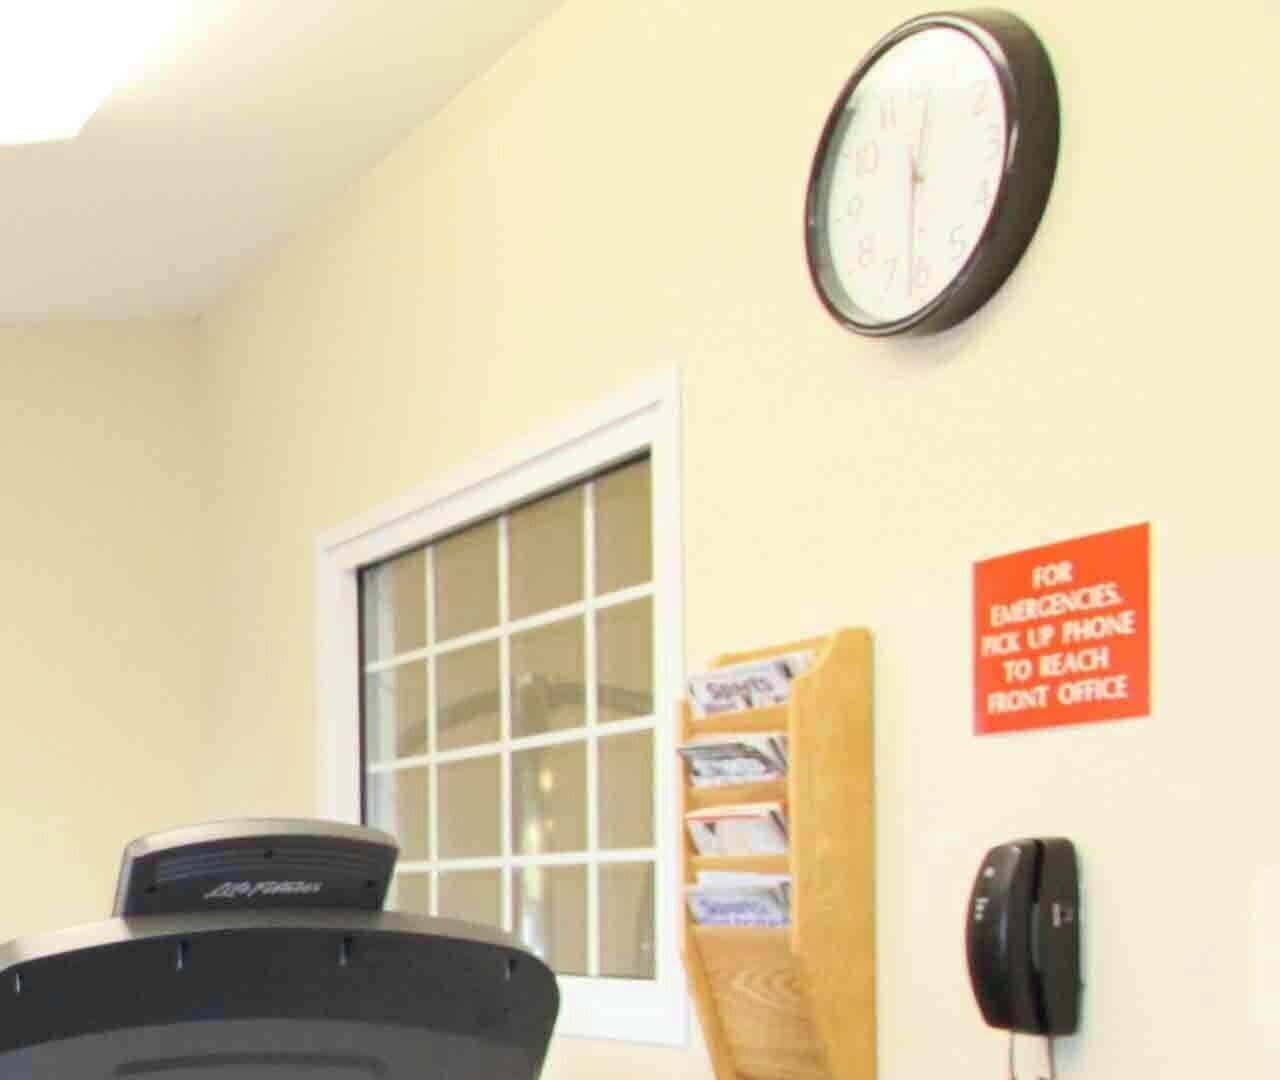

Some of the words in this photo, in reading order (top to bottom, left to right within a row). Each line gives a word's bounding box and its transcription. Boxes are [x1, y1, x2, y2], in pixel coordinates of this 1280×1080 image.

[1032, 561, 1073, 589] FOR
[981, 632, 1021, 656] PICK
[1027, 625, 1054, 649] UP
[1061, 610, 1136, 644] PHONE
[1003, 659, 1032, 683] TO
[1040, 646, 1109, 677] REACH
[988, 685, 1050, 714] FRONT
[1058, 675, 1128, 704] OFFICE
